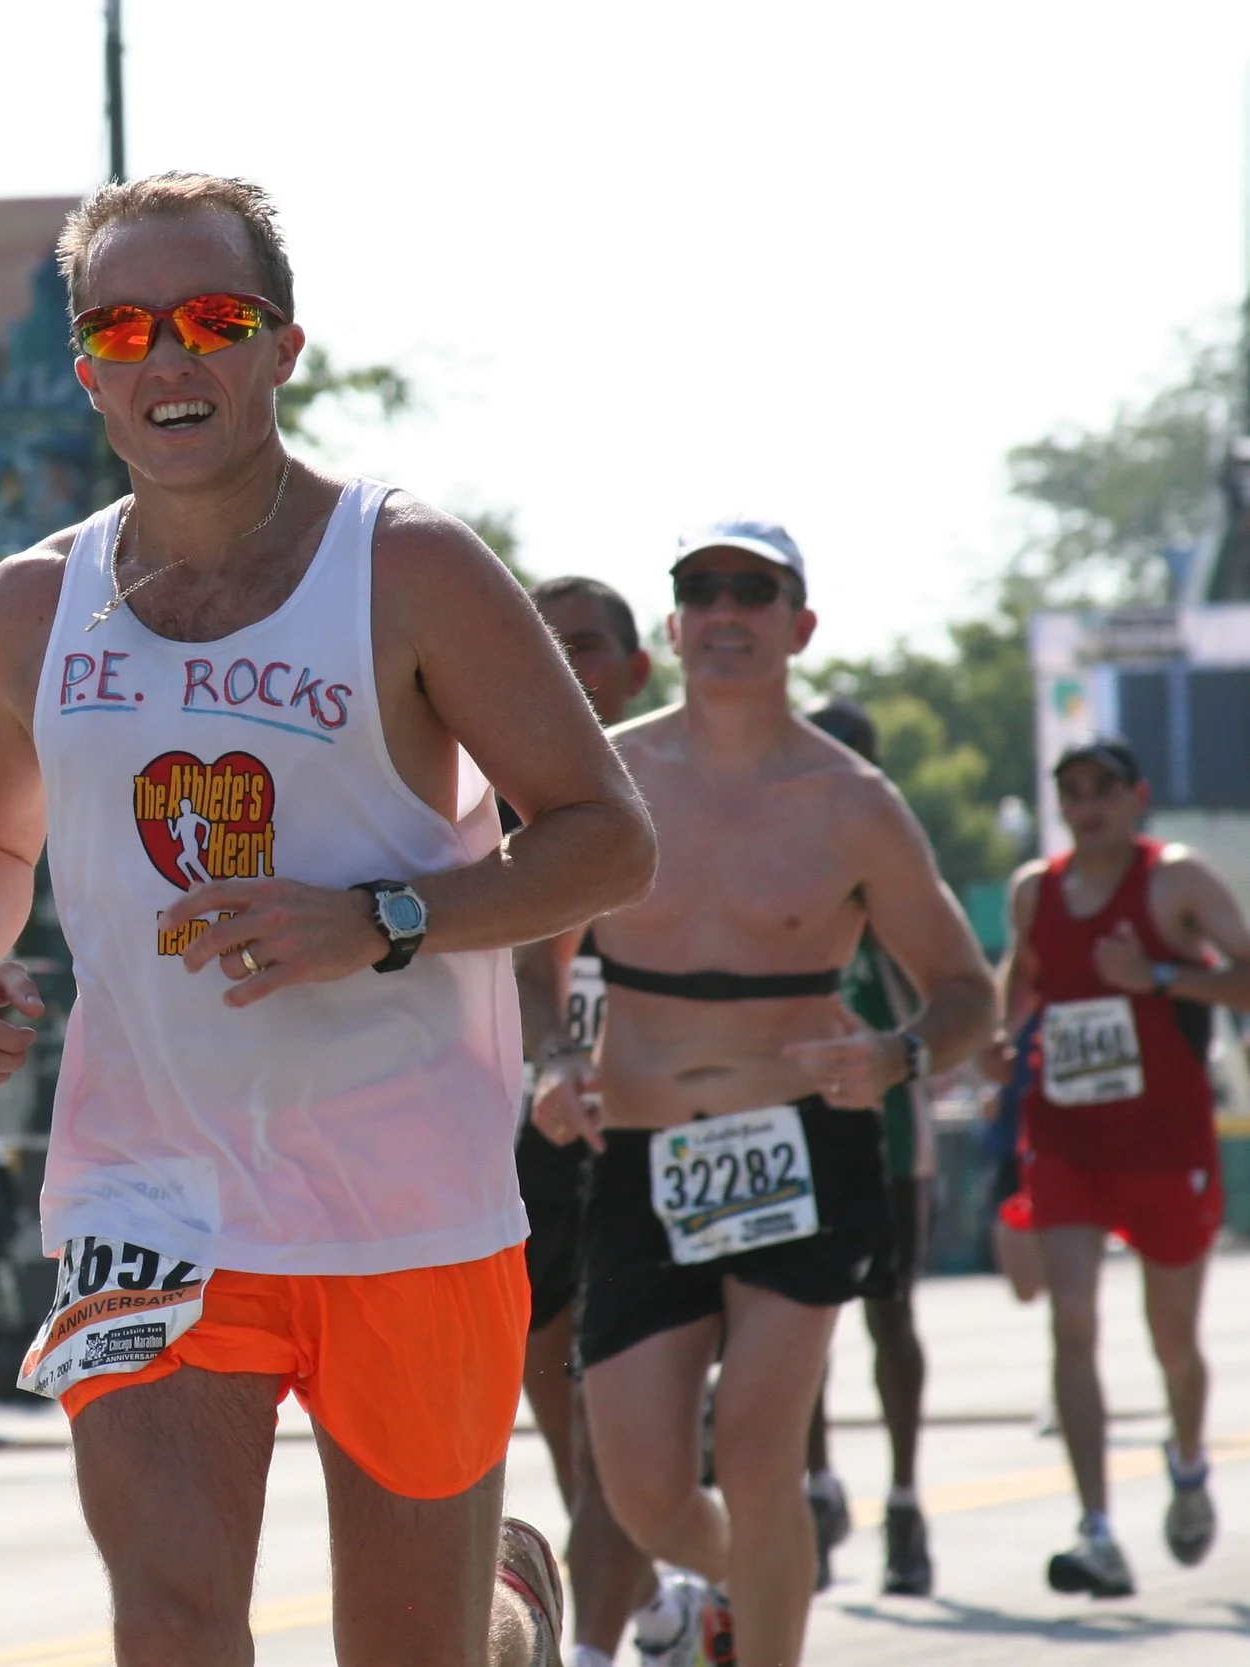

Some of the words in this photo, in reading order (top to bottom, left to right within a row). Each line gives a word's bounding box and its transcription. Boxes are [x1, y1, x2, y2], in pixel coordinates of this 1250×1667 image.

[60, 651, 144, 706] P.E.
[184, 658, 352, 731] ROCKS
[133, 775, 165, 821] The
[166, 764, 264, 822] Athlete's
[207, 821, 275, 878] Heart
[664, 1141, 800, 1210] 32282
[57, 1289, 187, 1340] ANNIVERSARY
[109, 1338, 133, 1351] Chicago
[133, 1335, 163, 1349] Marathon
[56, 1358, 73, 1379] 2007
